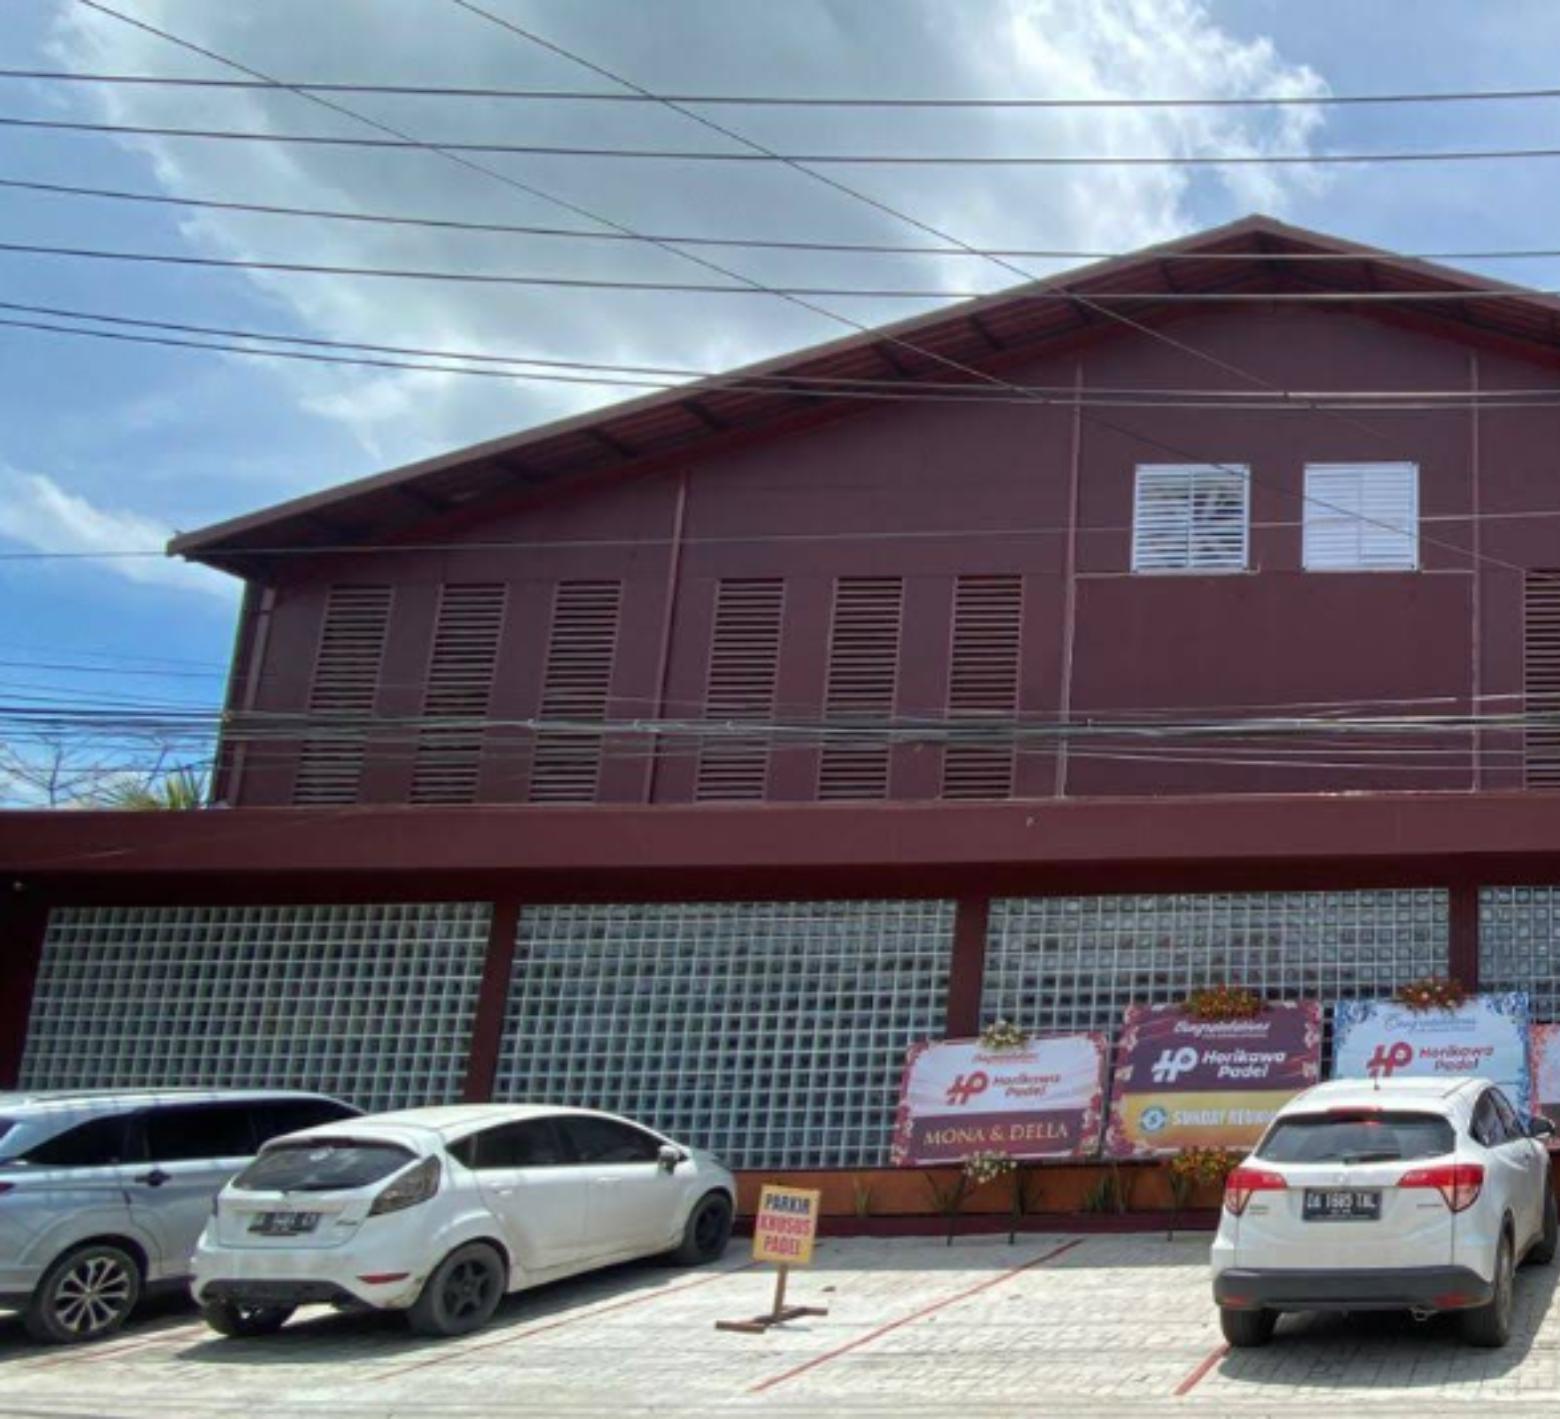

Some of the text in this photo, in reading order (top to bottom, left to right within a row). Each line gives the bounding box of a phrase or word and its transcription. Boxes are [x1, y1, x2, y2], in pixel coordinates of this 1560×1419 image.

[1201, 1050, 1285, 1064] Horikawa
[1419, 1044, 1494, 1058] Horikawa
[1217, 1065, 1268, 1078] Padel
[1434, 1058, 1479, 1070] Padel
[923, 1121, 1068, 1147] MONA & DELLA
[765, 1193, 810, 1216] PARKIR
[760, 1214, 812, 1236] KHUSUS
[764, 1235, 800, 1255] PADEL
